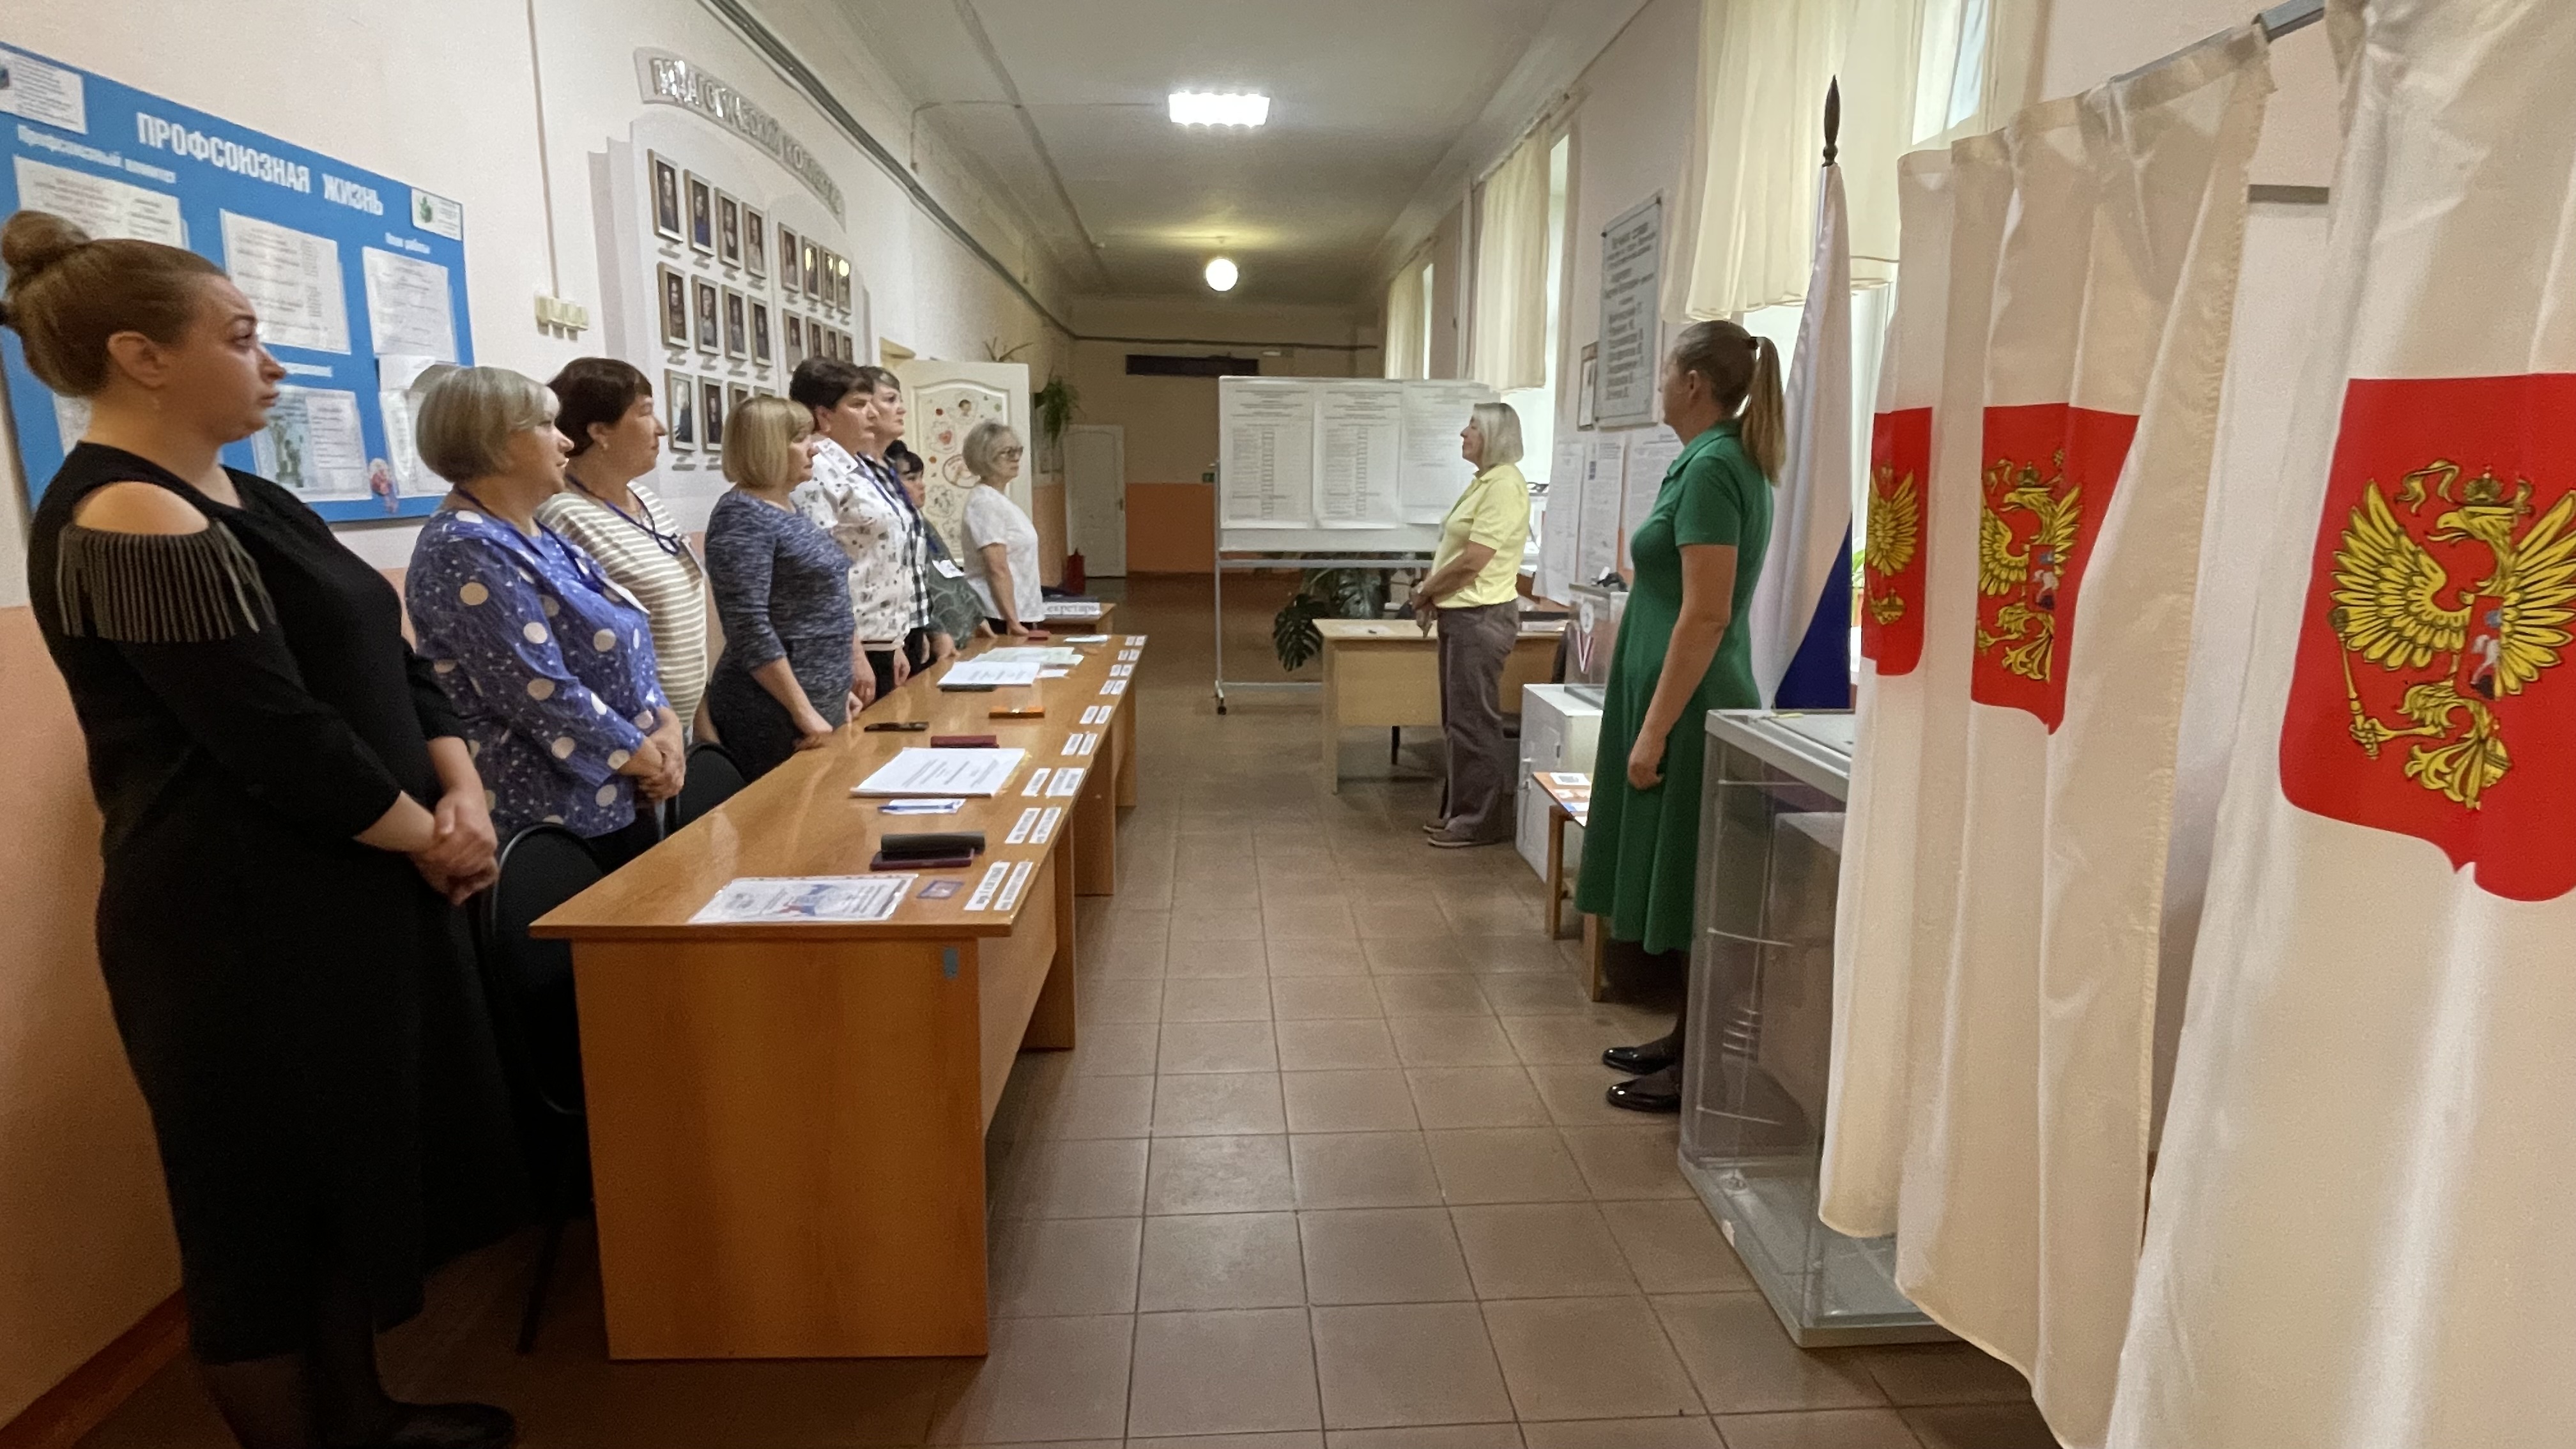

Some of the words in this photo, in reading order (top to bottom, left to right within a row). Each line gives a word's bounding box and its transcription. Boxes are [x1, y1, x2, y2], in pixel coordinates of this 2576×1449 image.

[137, 112, 310, 194] ПРОФСОЮЗНАЯ
[322, 172, 383, 216] ЖИЗНЬ
[1046, 605, 1098, 615] екретарь
